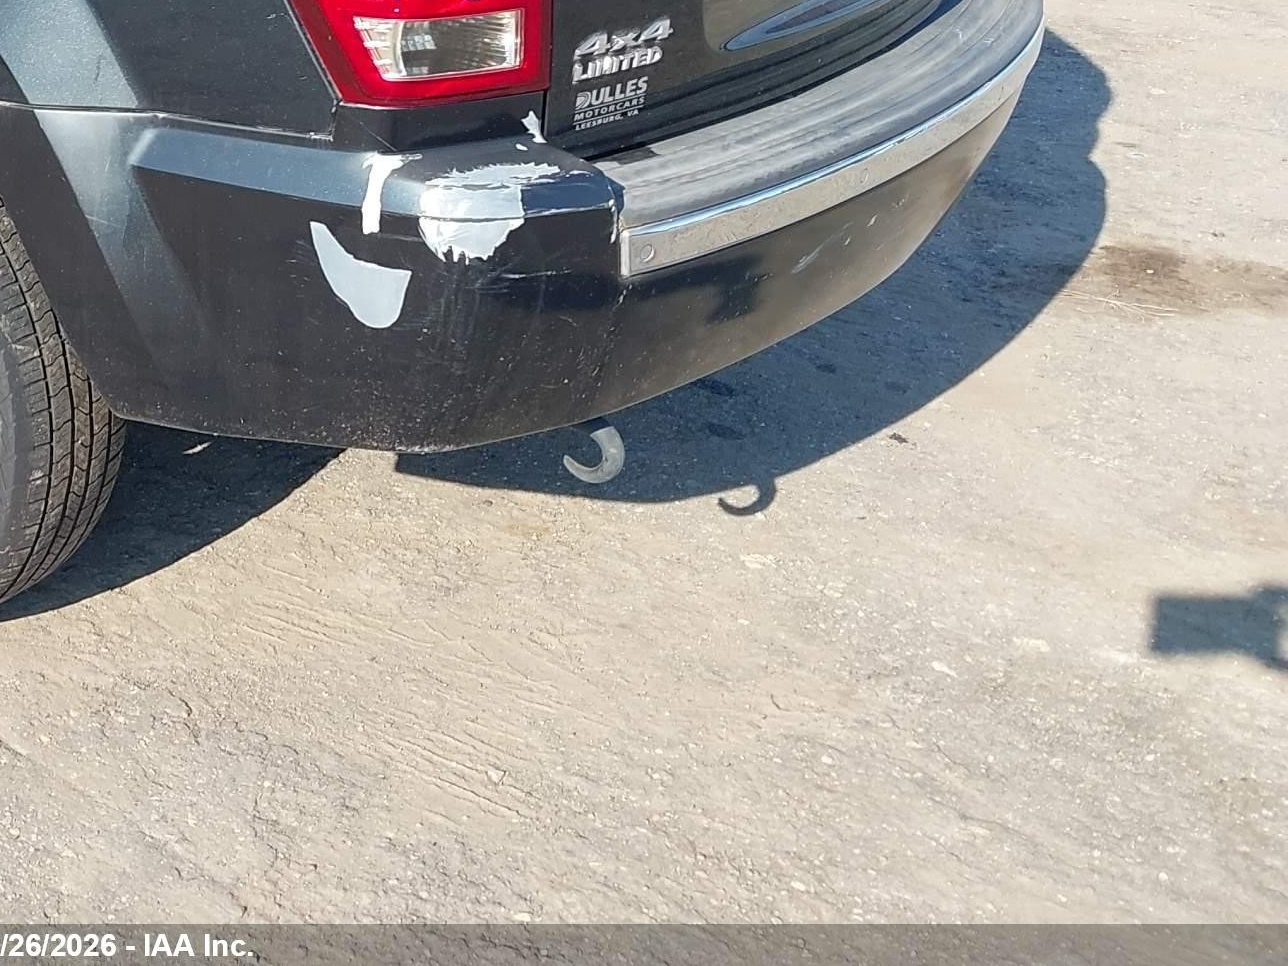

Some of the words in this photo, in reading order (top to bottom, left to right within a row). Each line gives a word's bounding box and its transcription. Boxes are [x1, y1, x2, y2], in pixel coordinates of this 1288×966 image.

[572, 46, 662, 84] LIMITED
[575, 76, 649, 110] DULLES
[574, 96, 645, 122] MOTORCARS
[627, 109, 639, 117] VA
